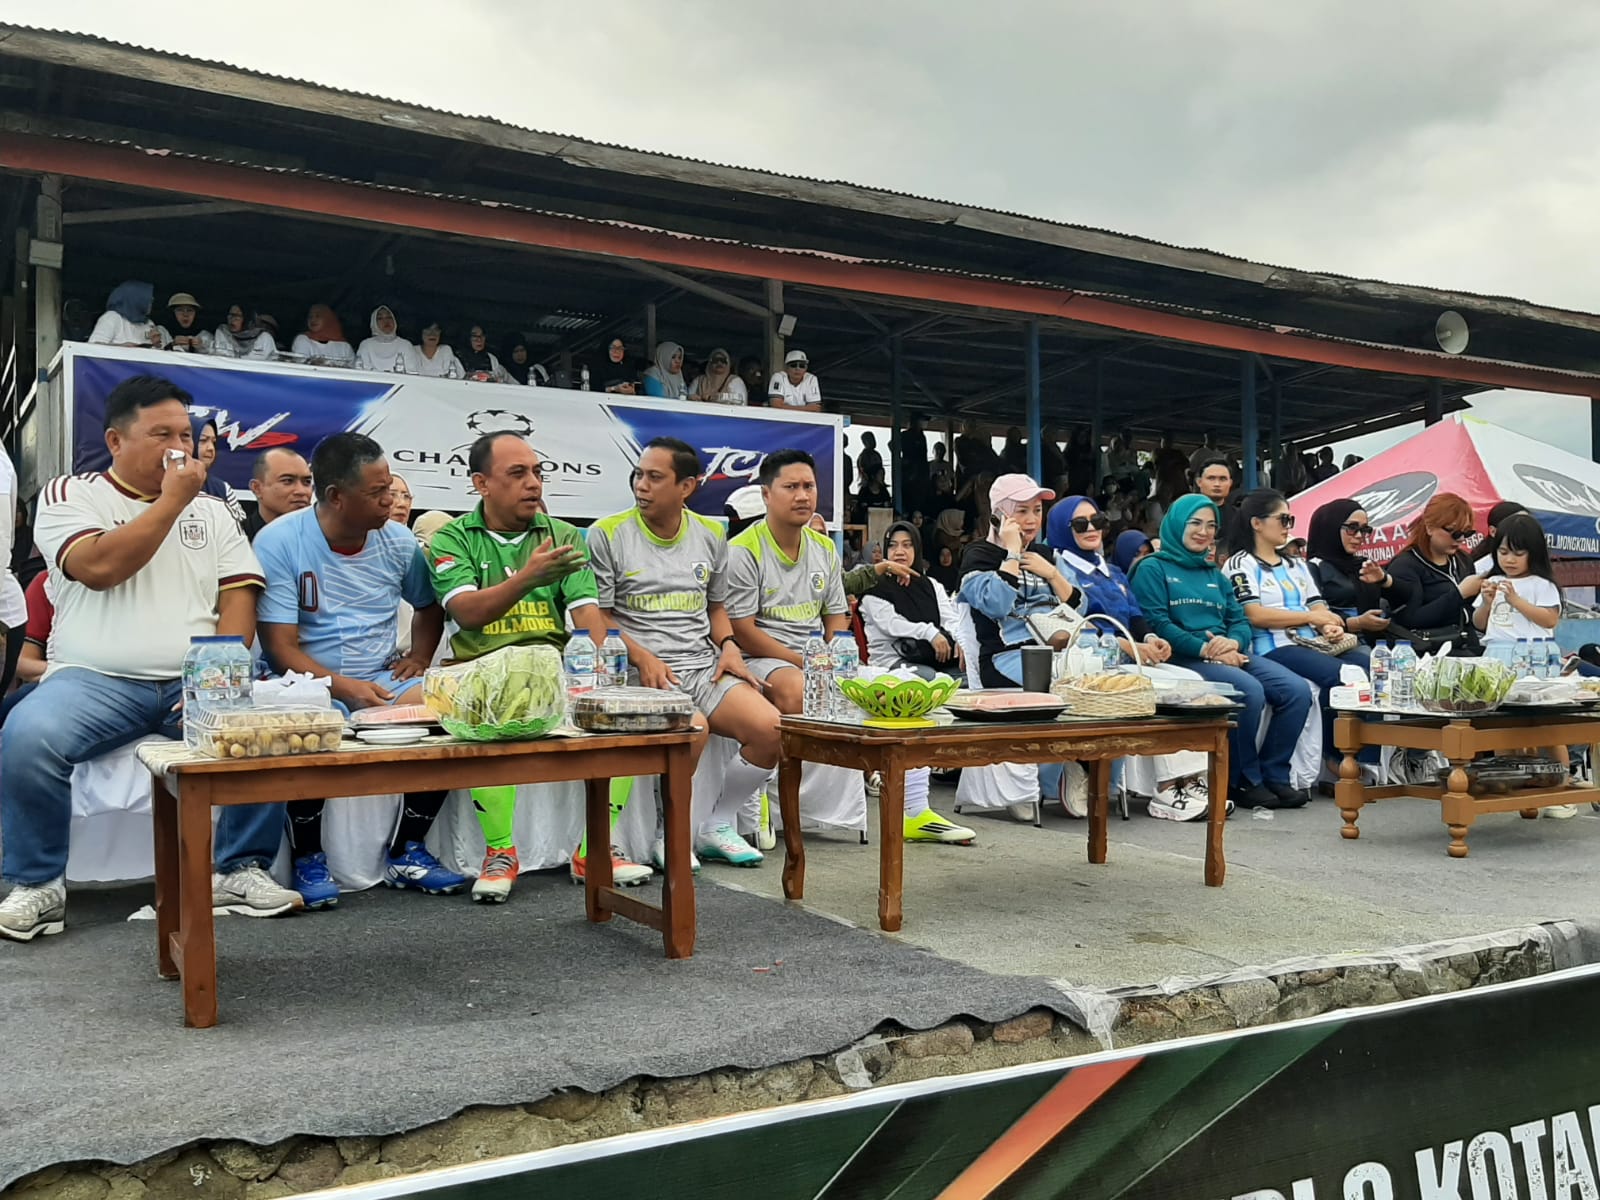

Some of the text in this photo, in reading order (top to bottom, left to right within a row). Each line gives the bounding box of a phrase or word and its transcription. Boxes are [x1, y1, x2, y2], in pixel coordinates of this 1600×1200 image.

[393, 449, 602, 476] CHAONS
[701, 446, 768, 486] TC
[1415, 1104, 1600, 1200] KOTA
